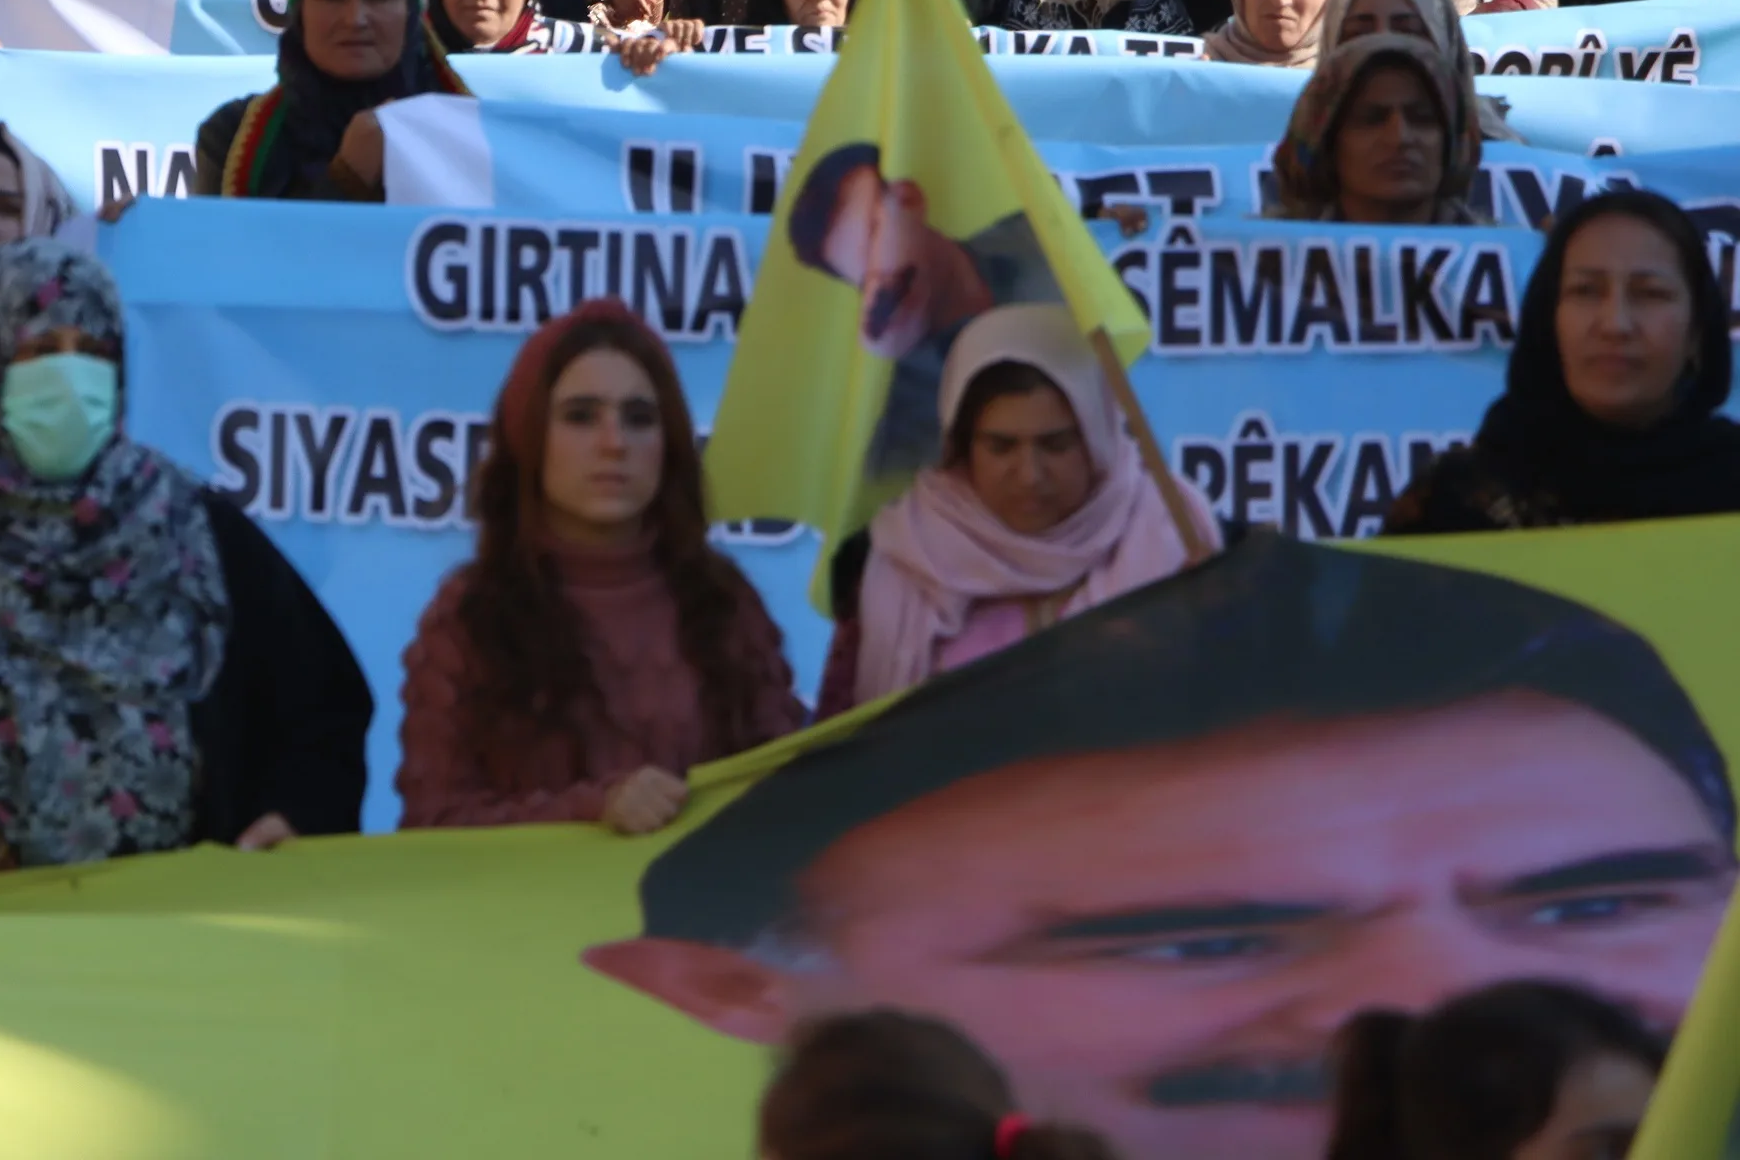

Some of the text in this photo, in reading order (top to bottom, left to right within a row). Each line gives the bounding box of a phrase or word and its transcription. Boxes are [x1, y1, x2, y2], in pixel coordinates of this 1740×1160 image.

[412, 221, 748, 334] GIRTINA
[217, 408, 1472, 538] SIYAS PÊKA
